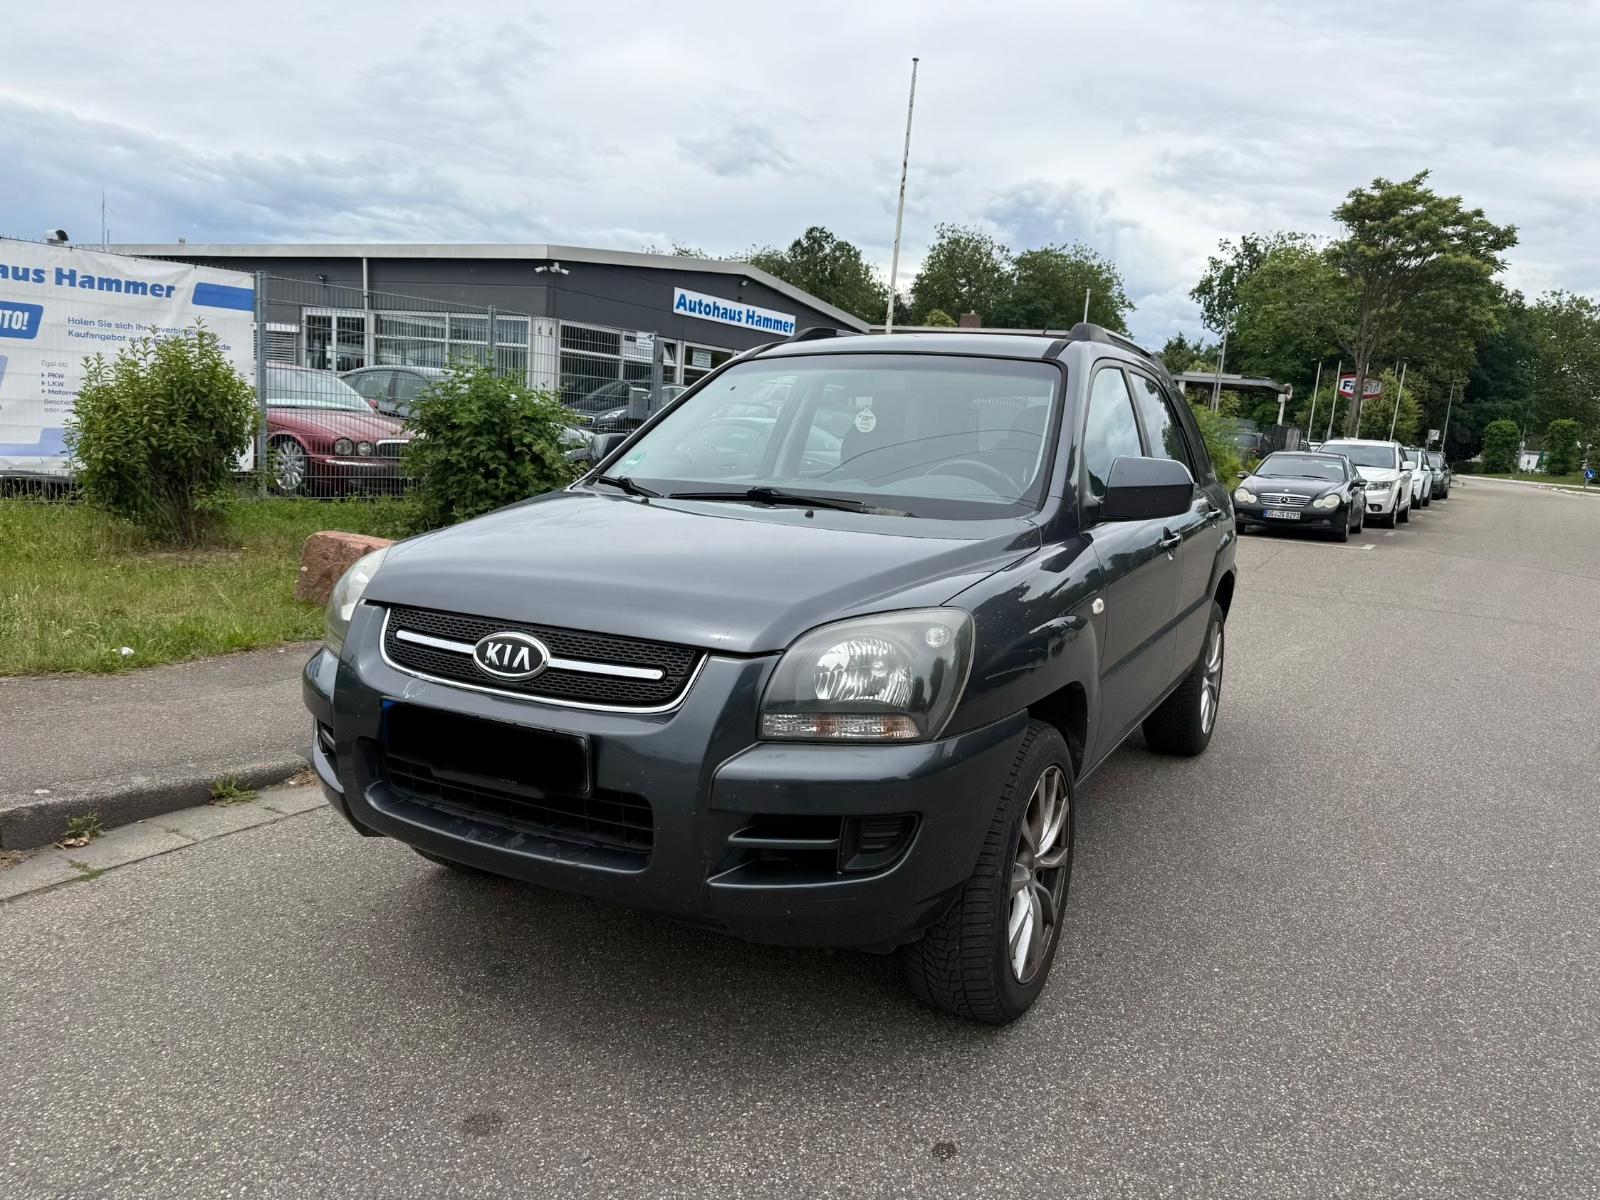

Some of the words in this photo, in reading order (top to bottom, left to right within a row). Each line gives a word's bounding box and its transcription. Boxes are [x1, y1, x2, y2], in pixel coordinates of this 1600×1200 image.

[55, 267, 176, 298] Hammer
[0, 309, 29, 331] TO!
[67, 316, 95, 326] Holen
[97, 319, 112, 328] Sie
[114, 321, 134, 330] sich
[675, 293, 743, 323] Autohaus
[745, 308, 795, 334] Hammer
[68, 329, 126, 342] Kaufangebot
[485, 641, 530, 671] KIA
